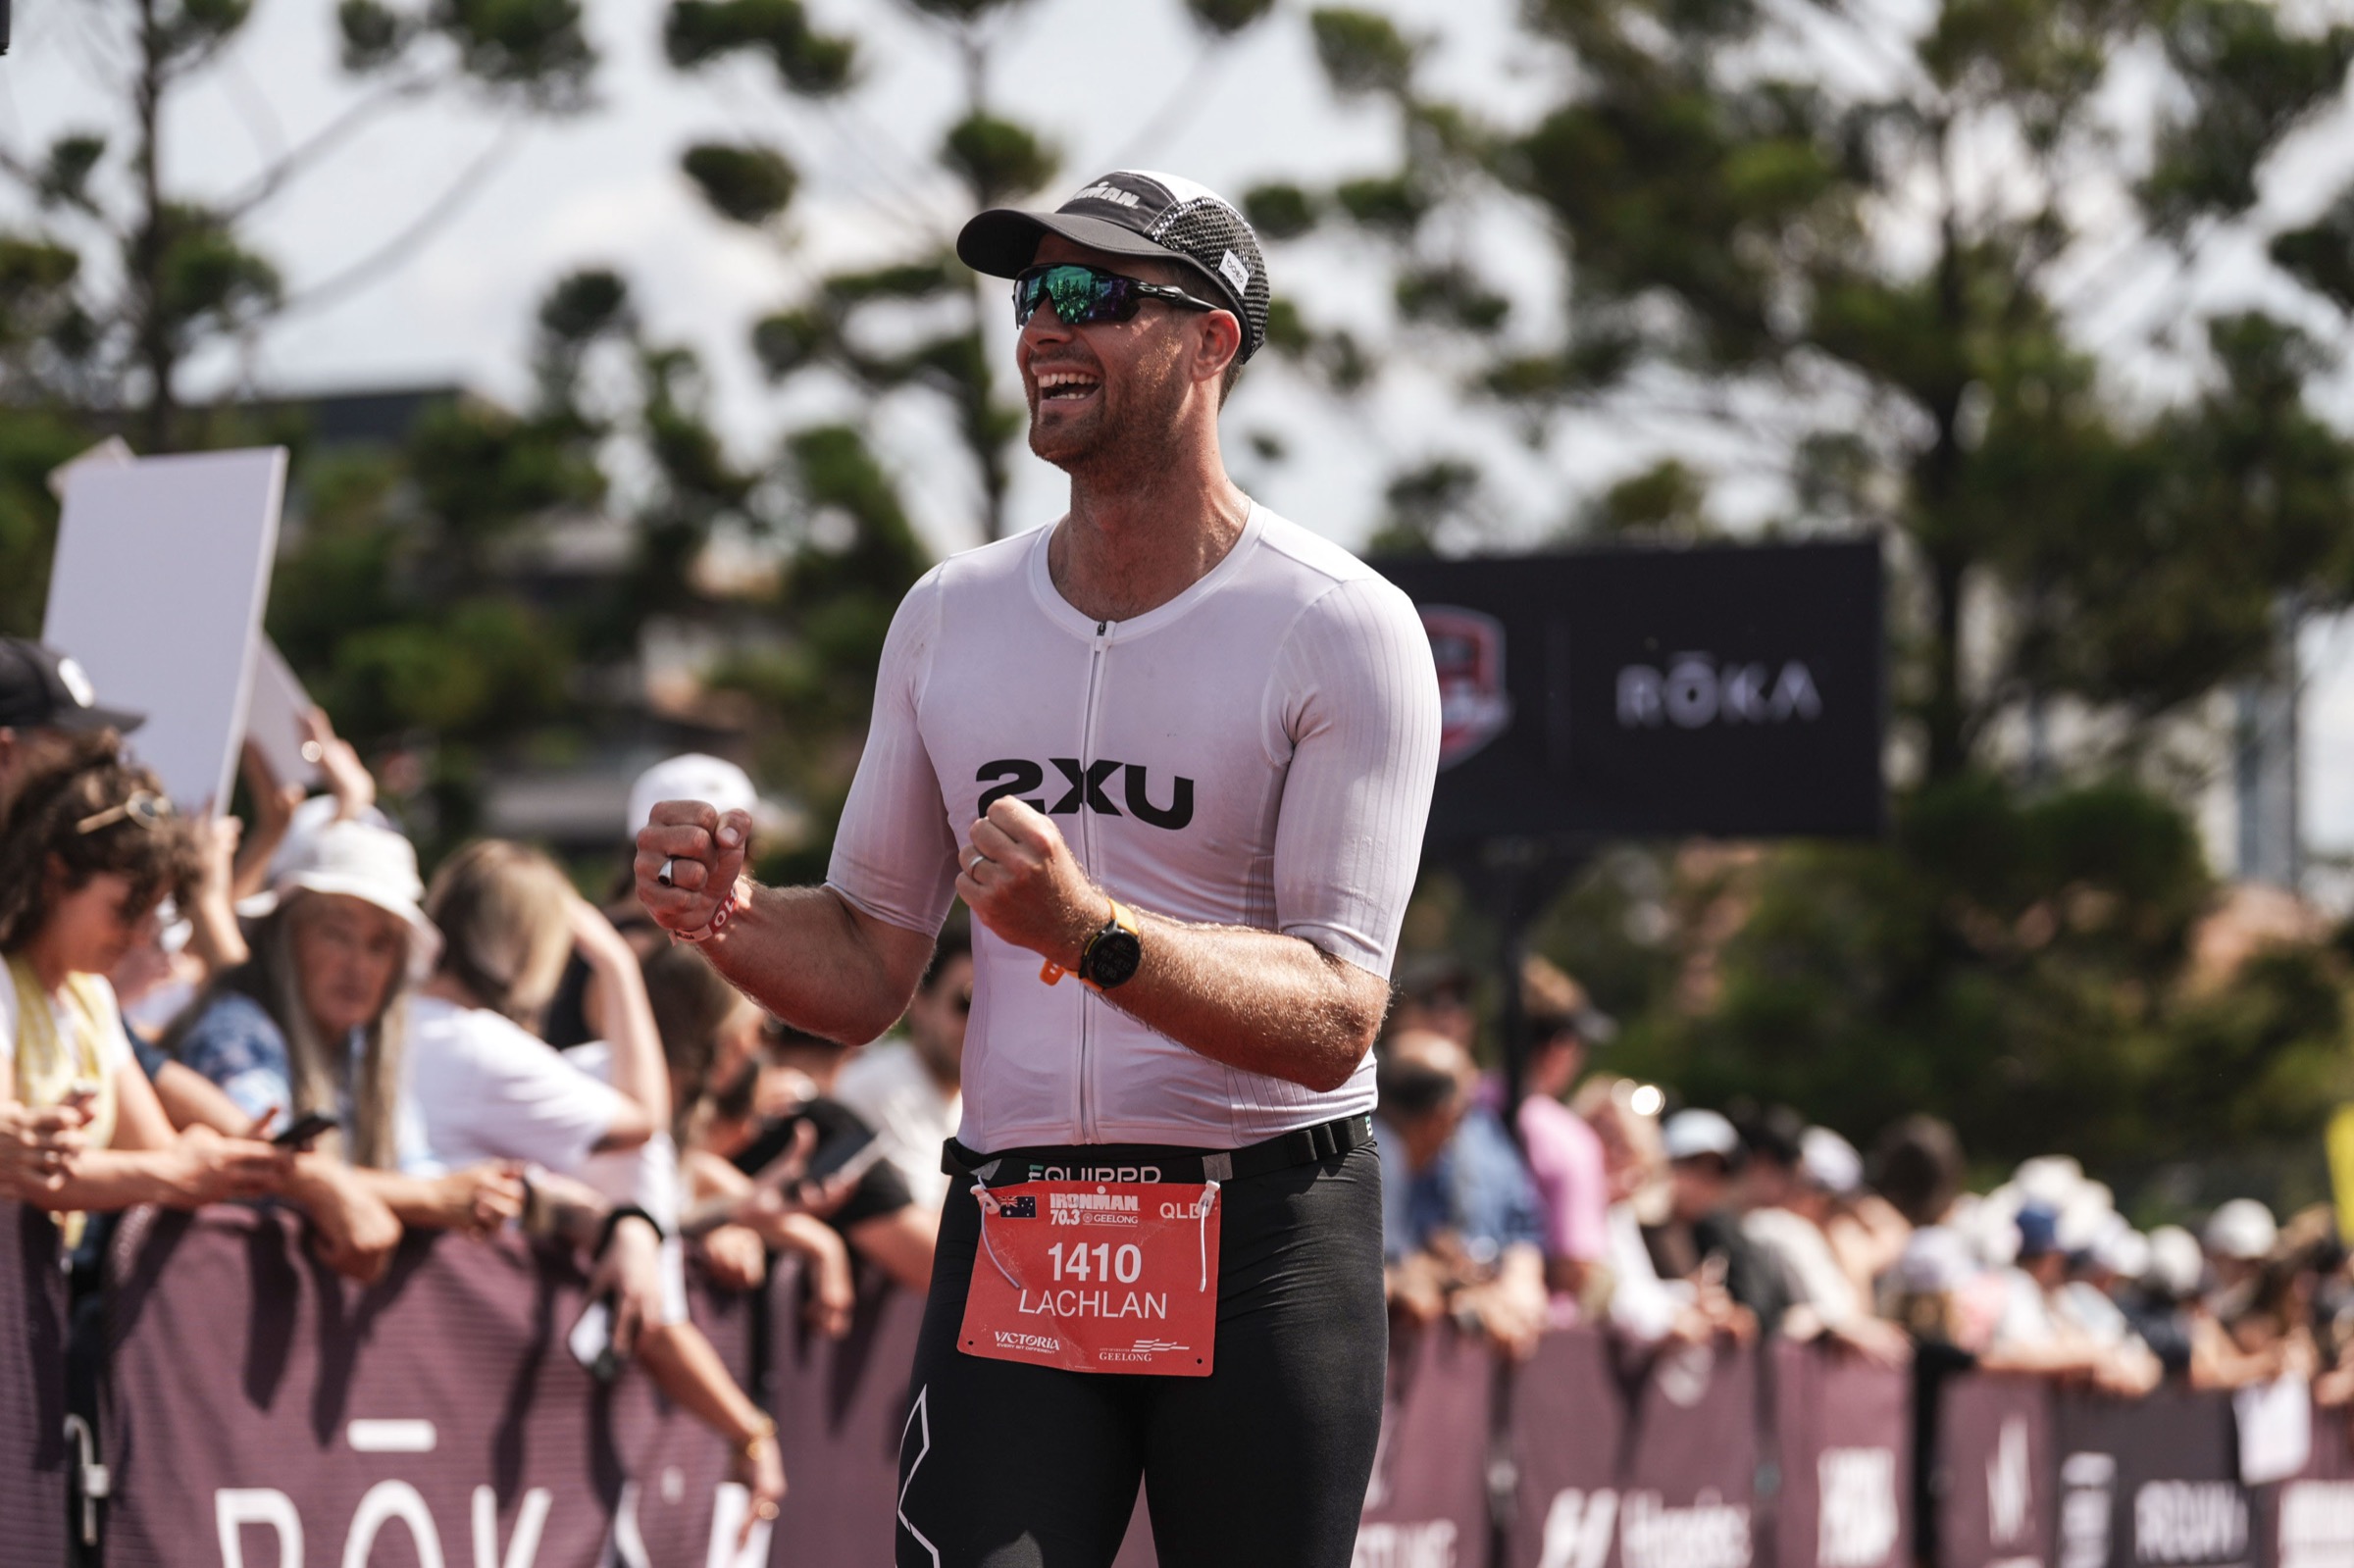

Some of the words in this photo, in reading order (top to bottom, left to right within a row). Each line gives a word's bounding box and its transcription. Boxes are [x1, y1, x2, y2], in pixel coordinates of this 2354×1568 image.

[976, 758, 1195, 831] 2XU
[1049, 1188, 1140, 1211] IRONMAN
[1050, 1209, 1081, 1226] 70.3
[1094, 1214, 1138, 1224] GEELONG
[1048, 1242, 1142, 1284] 1410
[1018, 1289, 1167, 1319] LACHLAN
[1099, 1352, 1152, 1362] GEELONG
